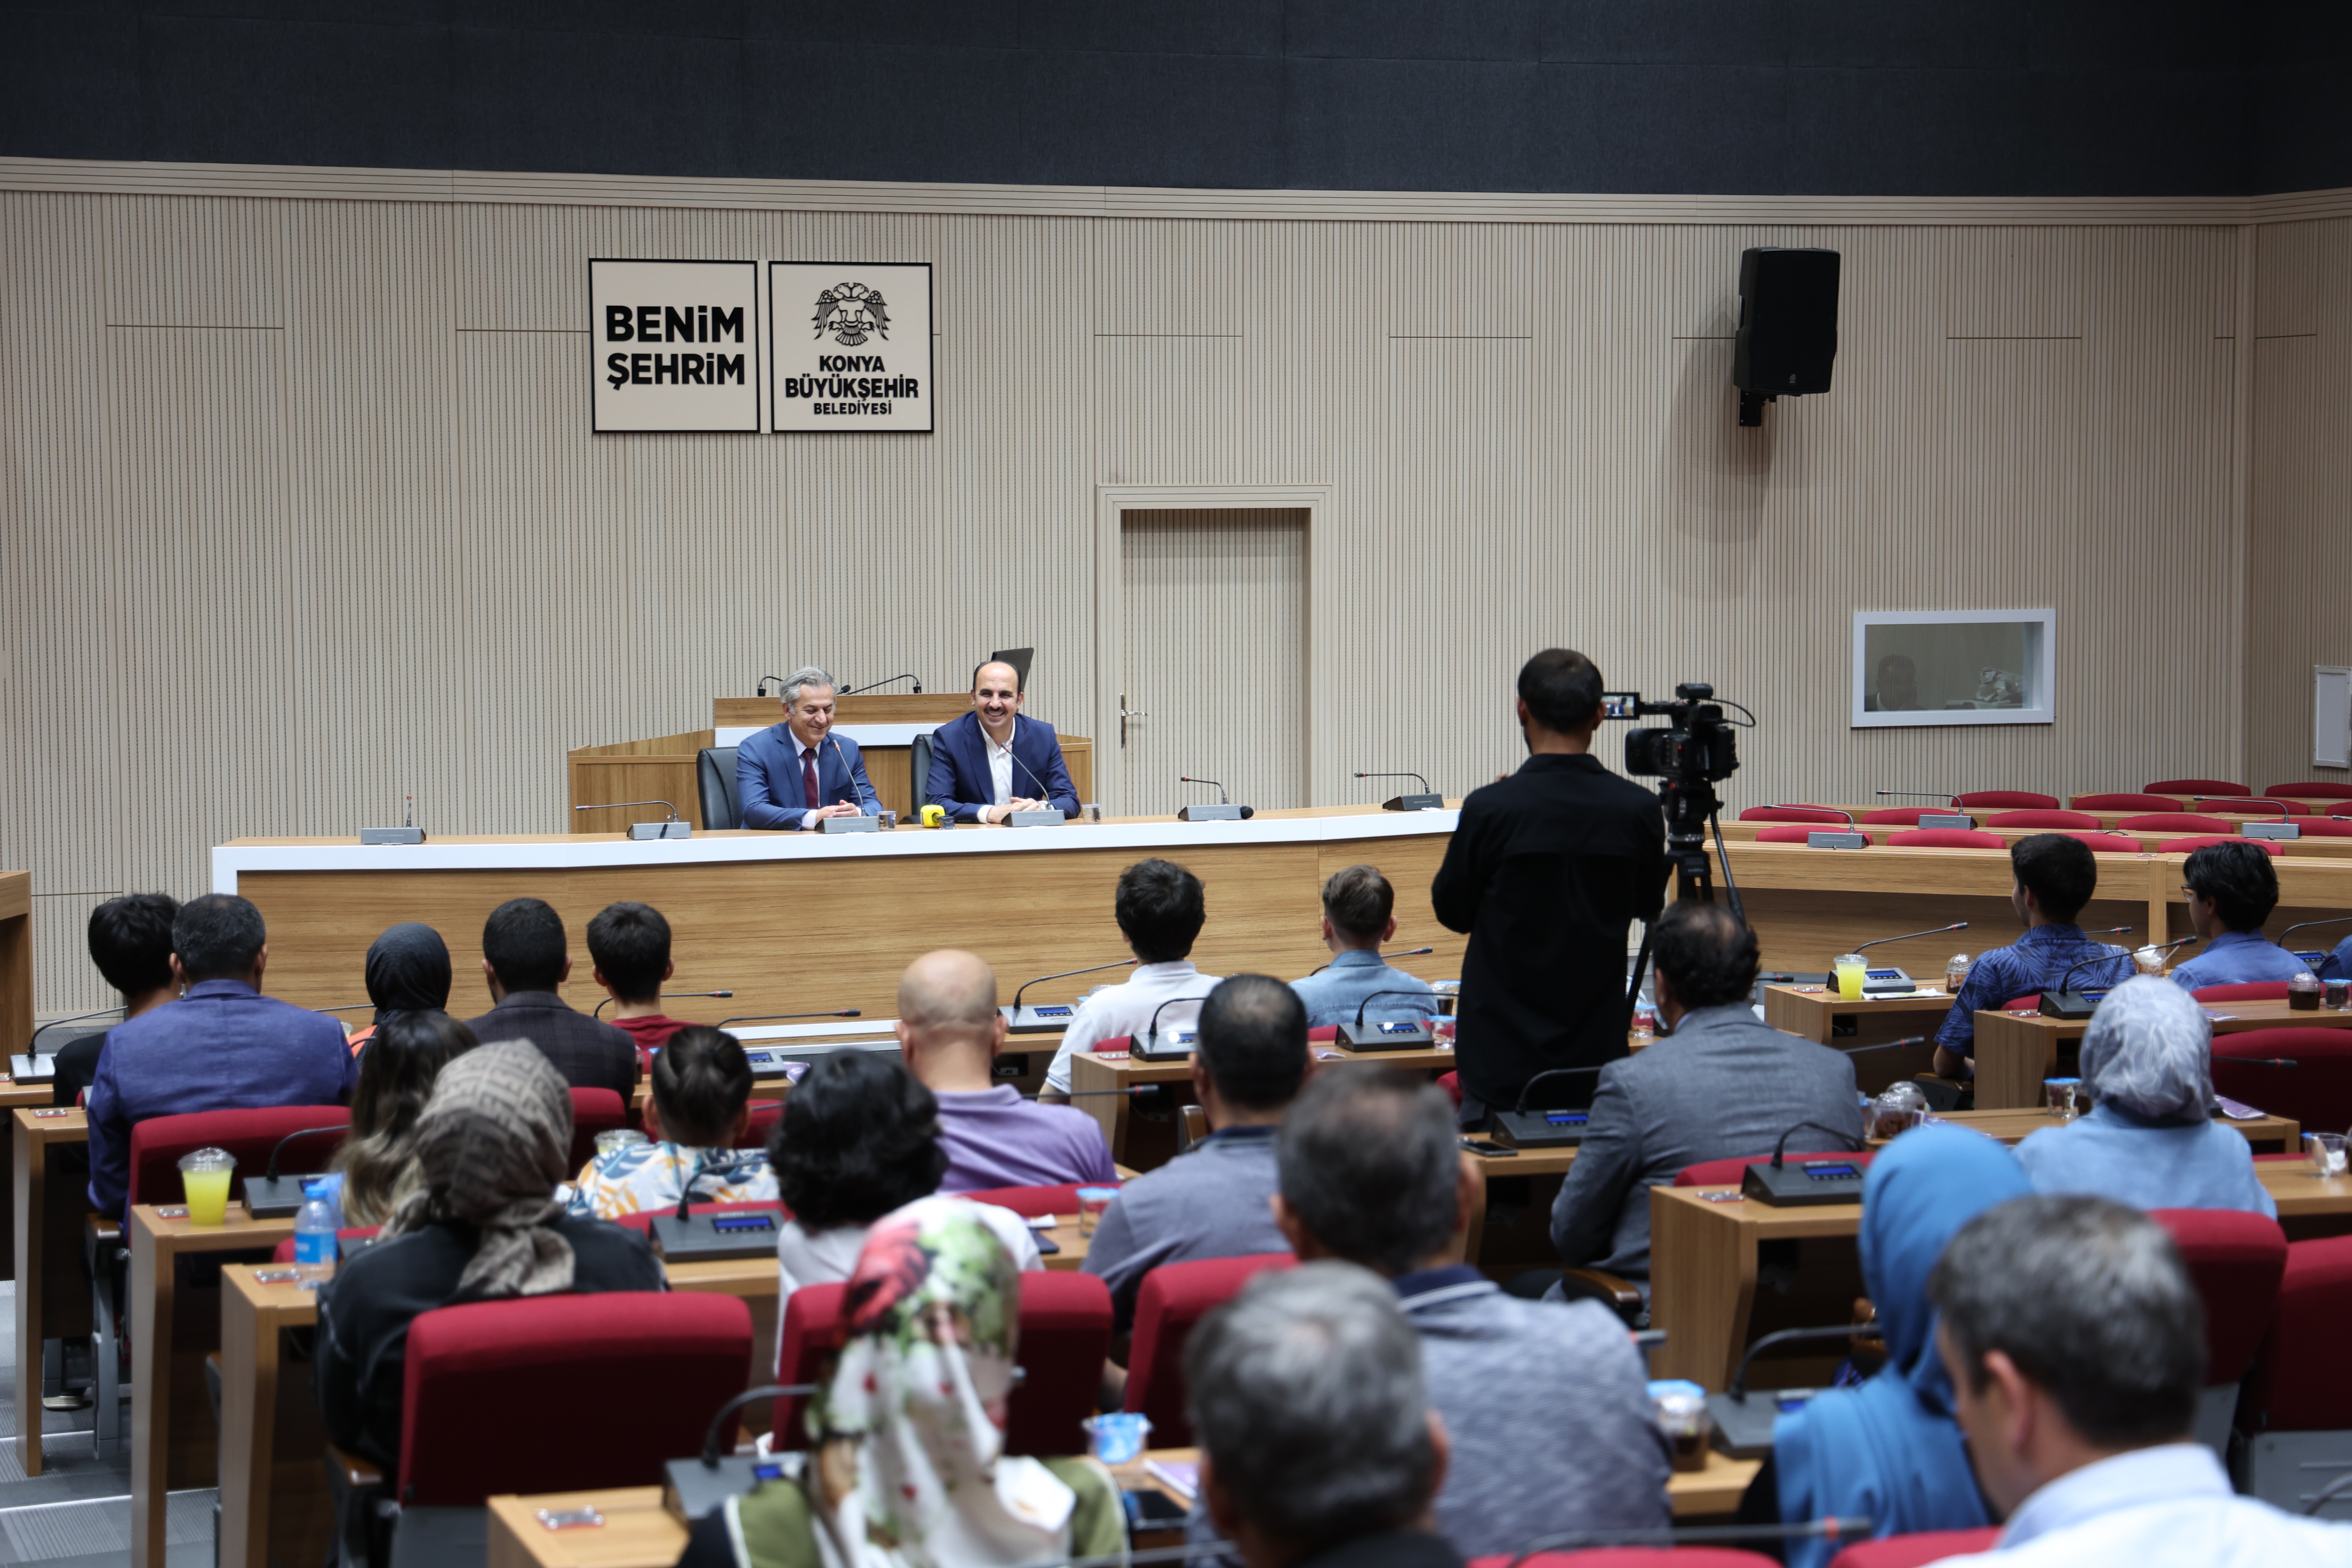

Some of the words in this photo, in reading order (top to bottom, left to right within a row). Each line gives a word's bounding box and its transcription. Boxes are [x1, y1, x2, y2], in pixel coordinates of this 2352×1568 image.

[819, 355, 885, 372] KONYA
[785, 373, 919, 401] BÜYÜKŞEHİR
[814, 399, 891, 415] BELEDİYESİ
